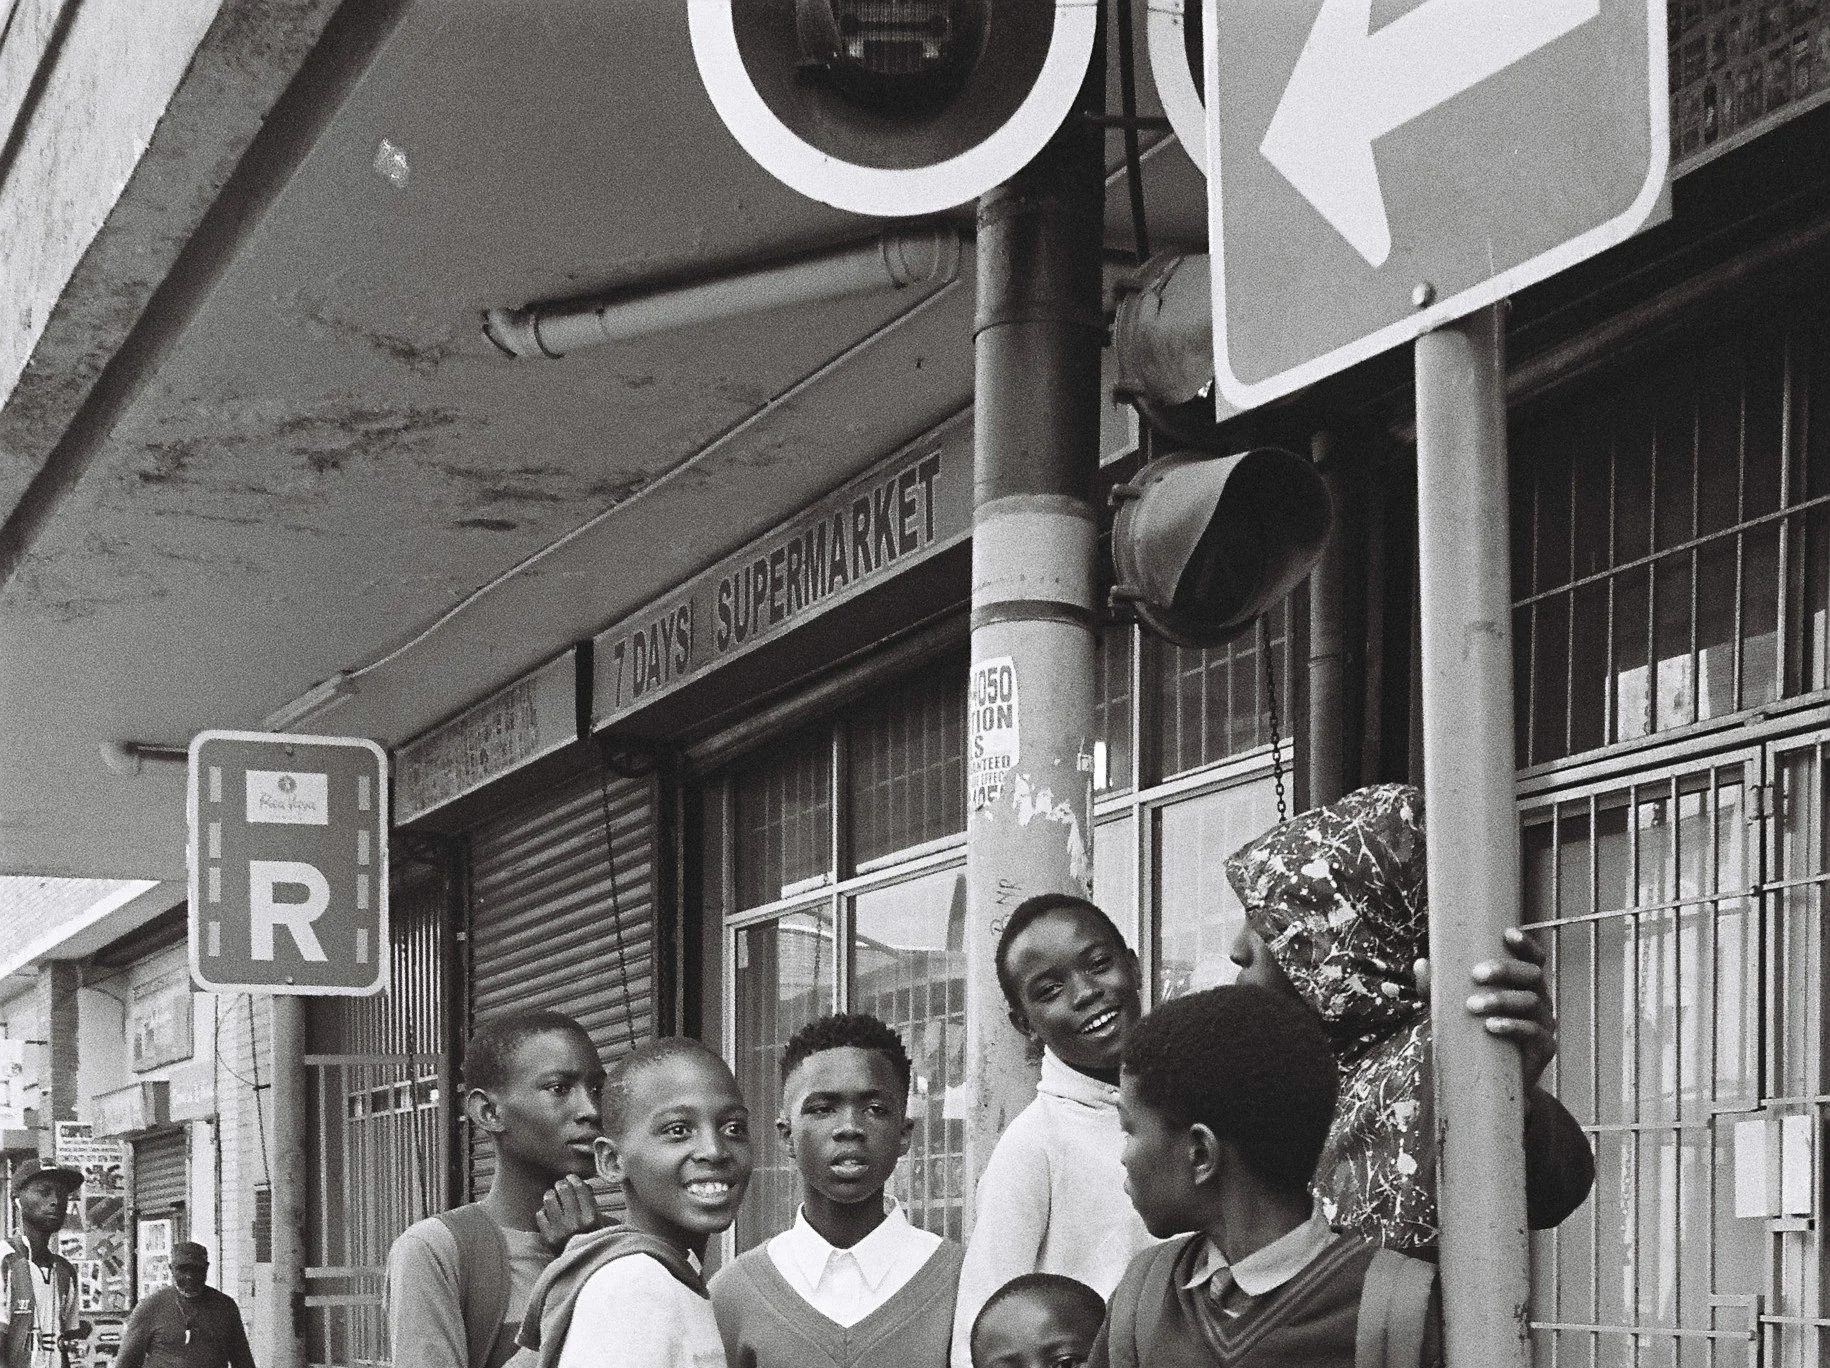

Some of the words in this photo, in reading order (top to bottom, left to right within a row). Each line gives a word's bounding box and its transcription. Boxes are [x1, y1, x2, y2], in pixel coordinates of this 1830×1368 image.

[614, 637, 627, 708] 7
[632, 605, 691, 698] DAYS
[717, 455, 941, 653] SUPERMARKET
[249, 860, 330, 962] R
